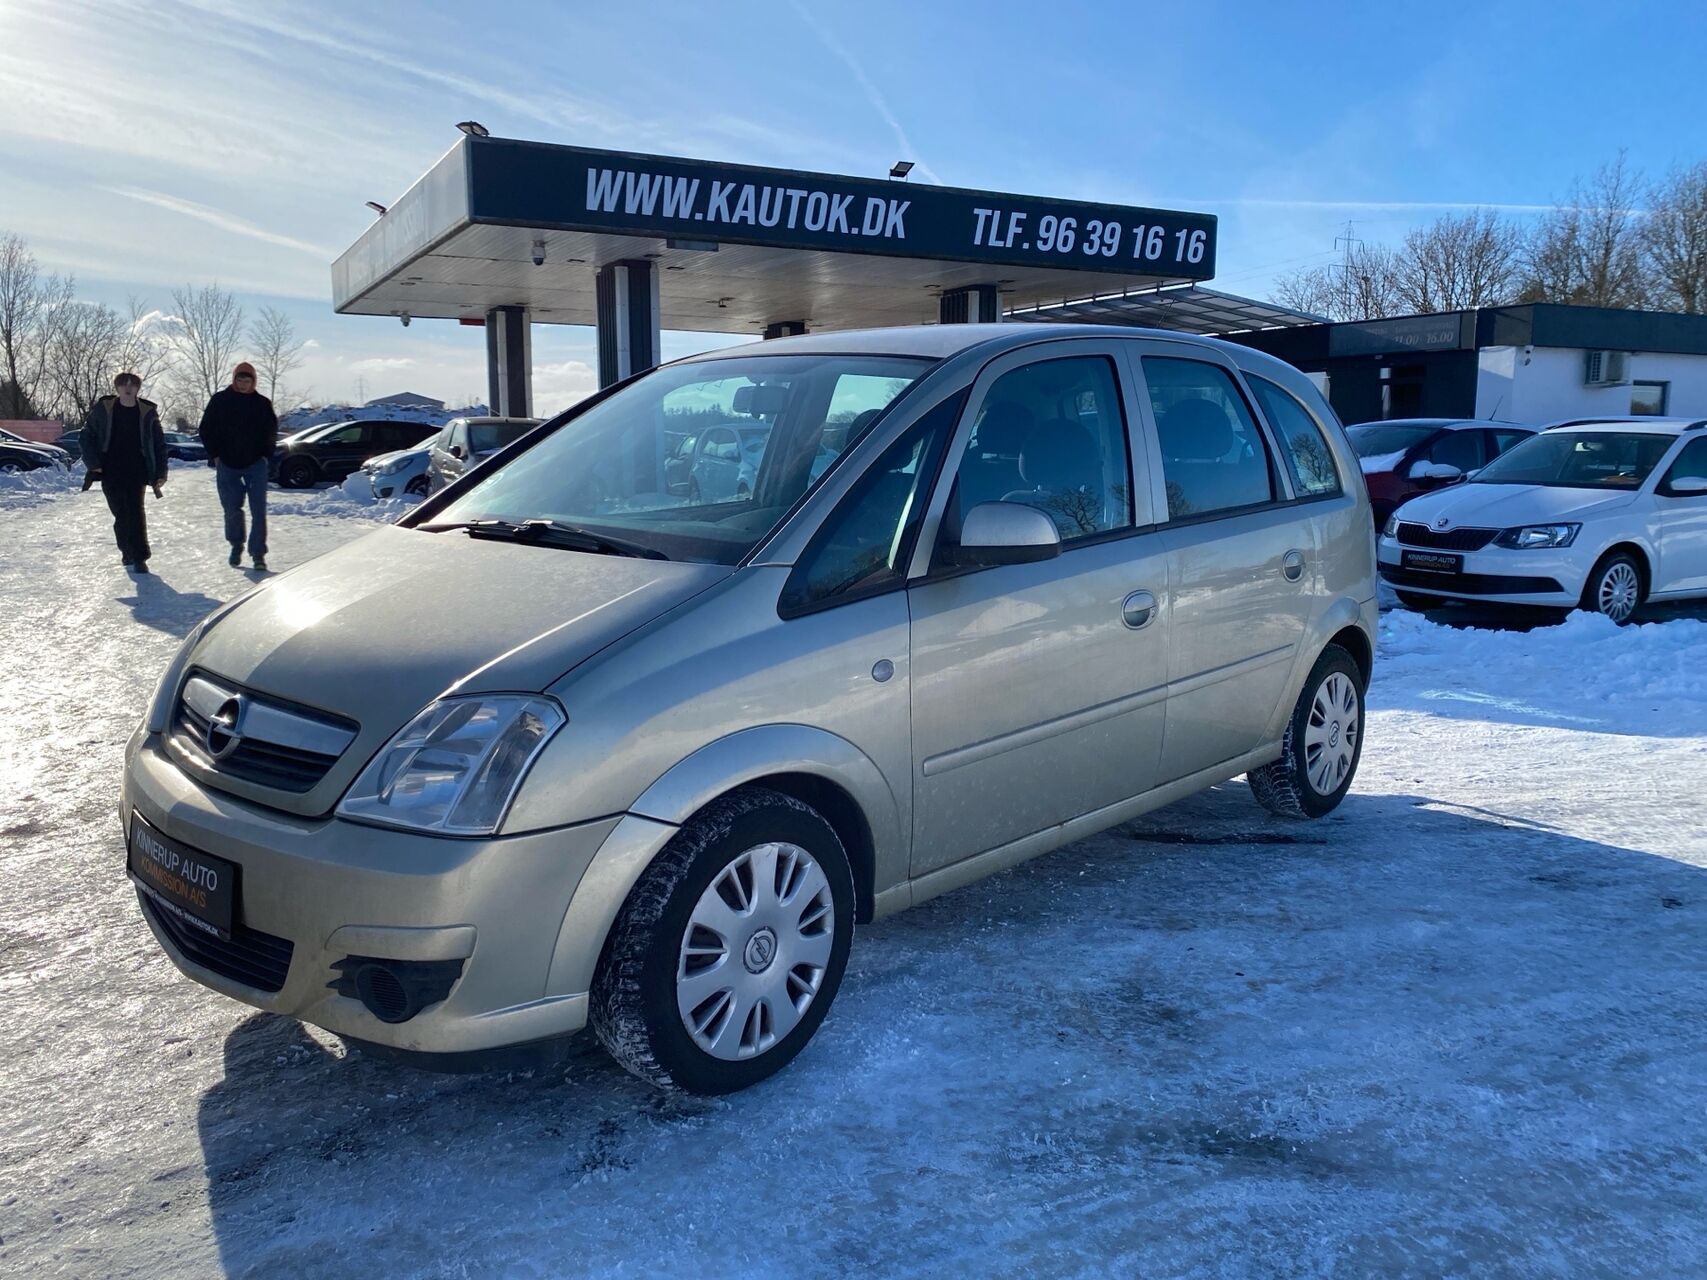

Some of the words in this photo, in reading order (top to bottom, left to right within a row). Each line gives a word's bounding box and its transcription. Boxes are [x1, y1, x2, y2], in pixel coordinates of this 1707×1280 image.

[586, 168, 911, 239] WWW.KAUTOK.DK
[973, 208, 1030, 249] TLF.
[1037, 215, 1078, 253] 96
[1083, 220, 1122, 257] 39
[1132, 225, 1165, 260] 16
[1175, 229, 1207, 263] 16
[135, 826, 180, 871] KINNERUP
[181, 859, 218, 891] AUTO
[142, 855, 188, 898] KOMMISSION
[190, 887, 207, 908] A/S
